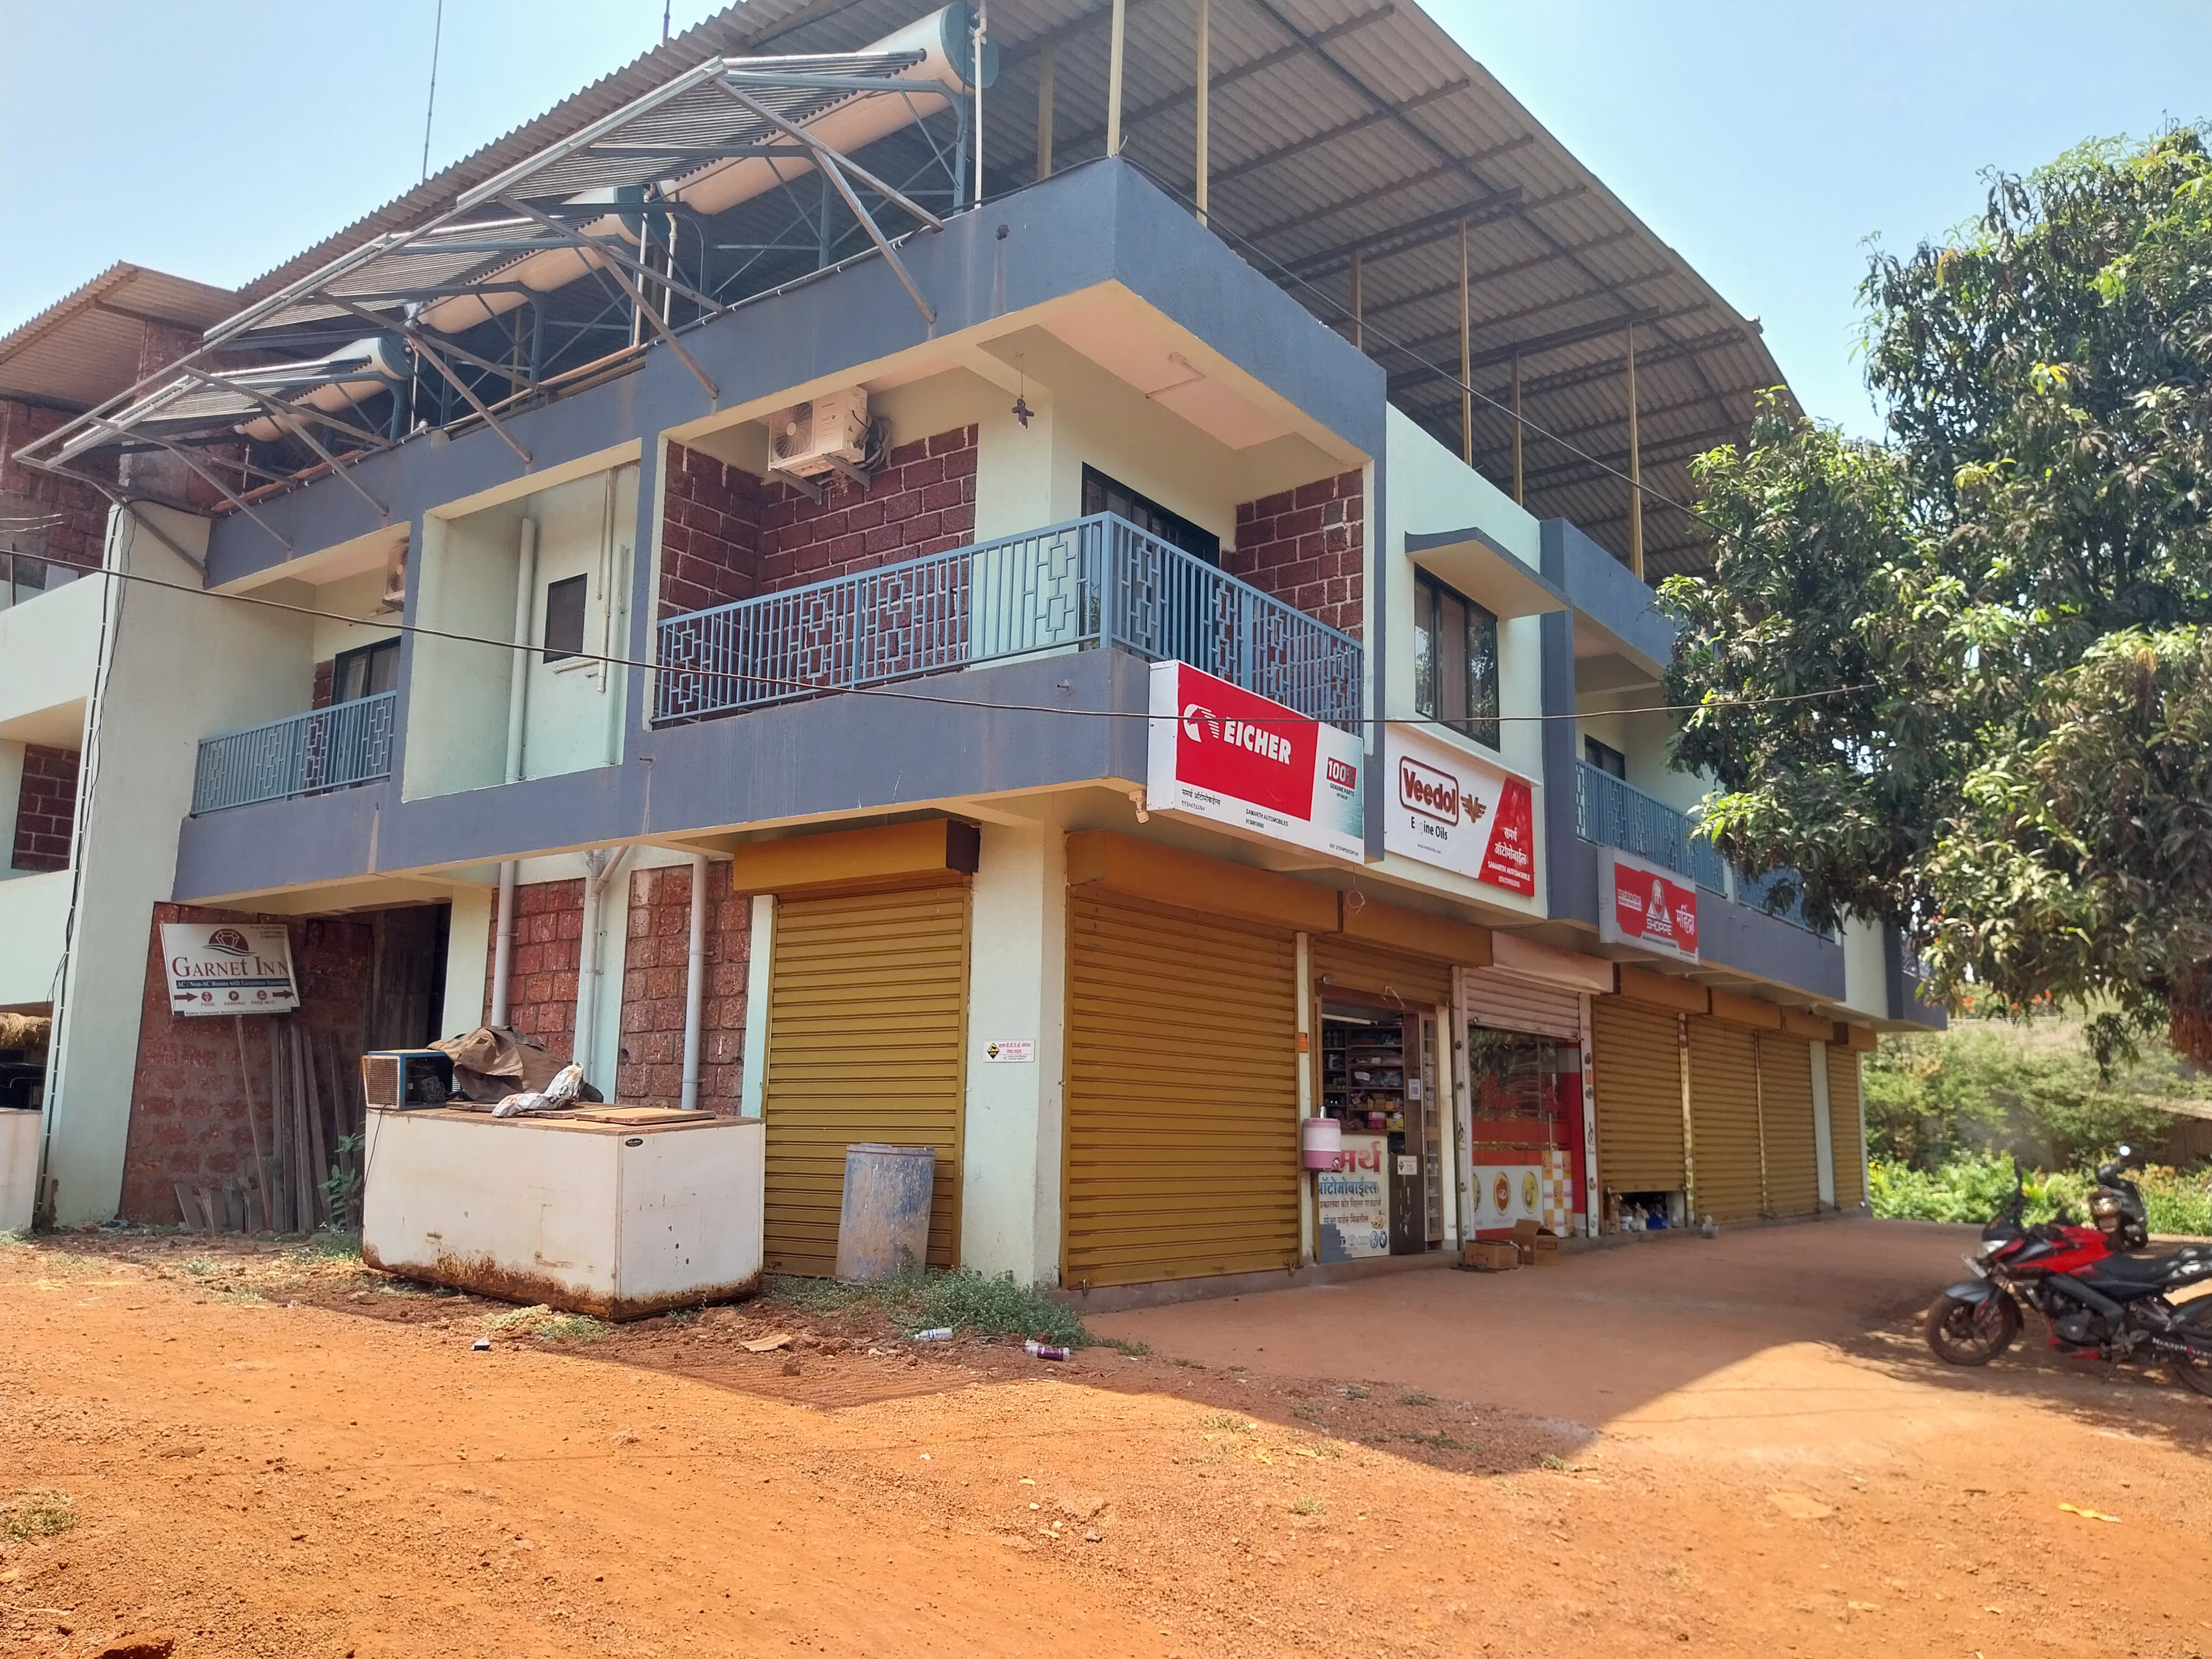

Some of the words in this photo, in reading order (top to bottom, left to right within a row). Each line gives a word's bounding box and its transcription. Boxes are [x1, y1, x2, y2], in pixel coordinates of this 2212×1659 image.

[1224, 716, 1291, 765] EICHER
[1328, 761, 1354, 787] 100%
[1330, 783, 1343, 793] GENUINE
[1344, 788, 1354, 796] PARTS
[1403, 768, 1456, 815] Veedol
[1246, 808, 1263, 819] SAMARTH
[1264, 814, 1288, 827] AUTOMOBILES
[1411, 816, 1434, 835] Eine
[1436, 826, 1448, 840] Oils
[1503, 827, 1517, 842] समर्थ
[1488, 861, 1506, 873] SAMARTH
[1507, 867, 1531, 882] AUTOMOBILE
[1647, 918, 1671, 935] SHOPPE
[253, 956, 289, 975] INN
[1340, 1141, 1381, 1173] मर्थ
